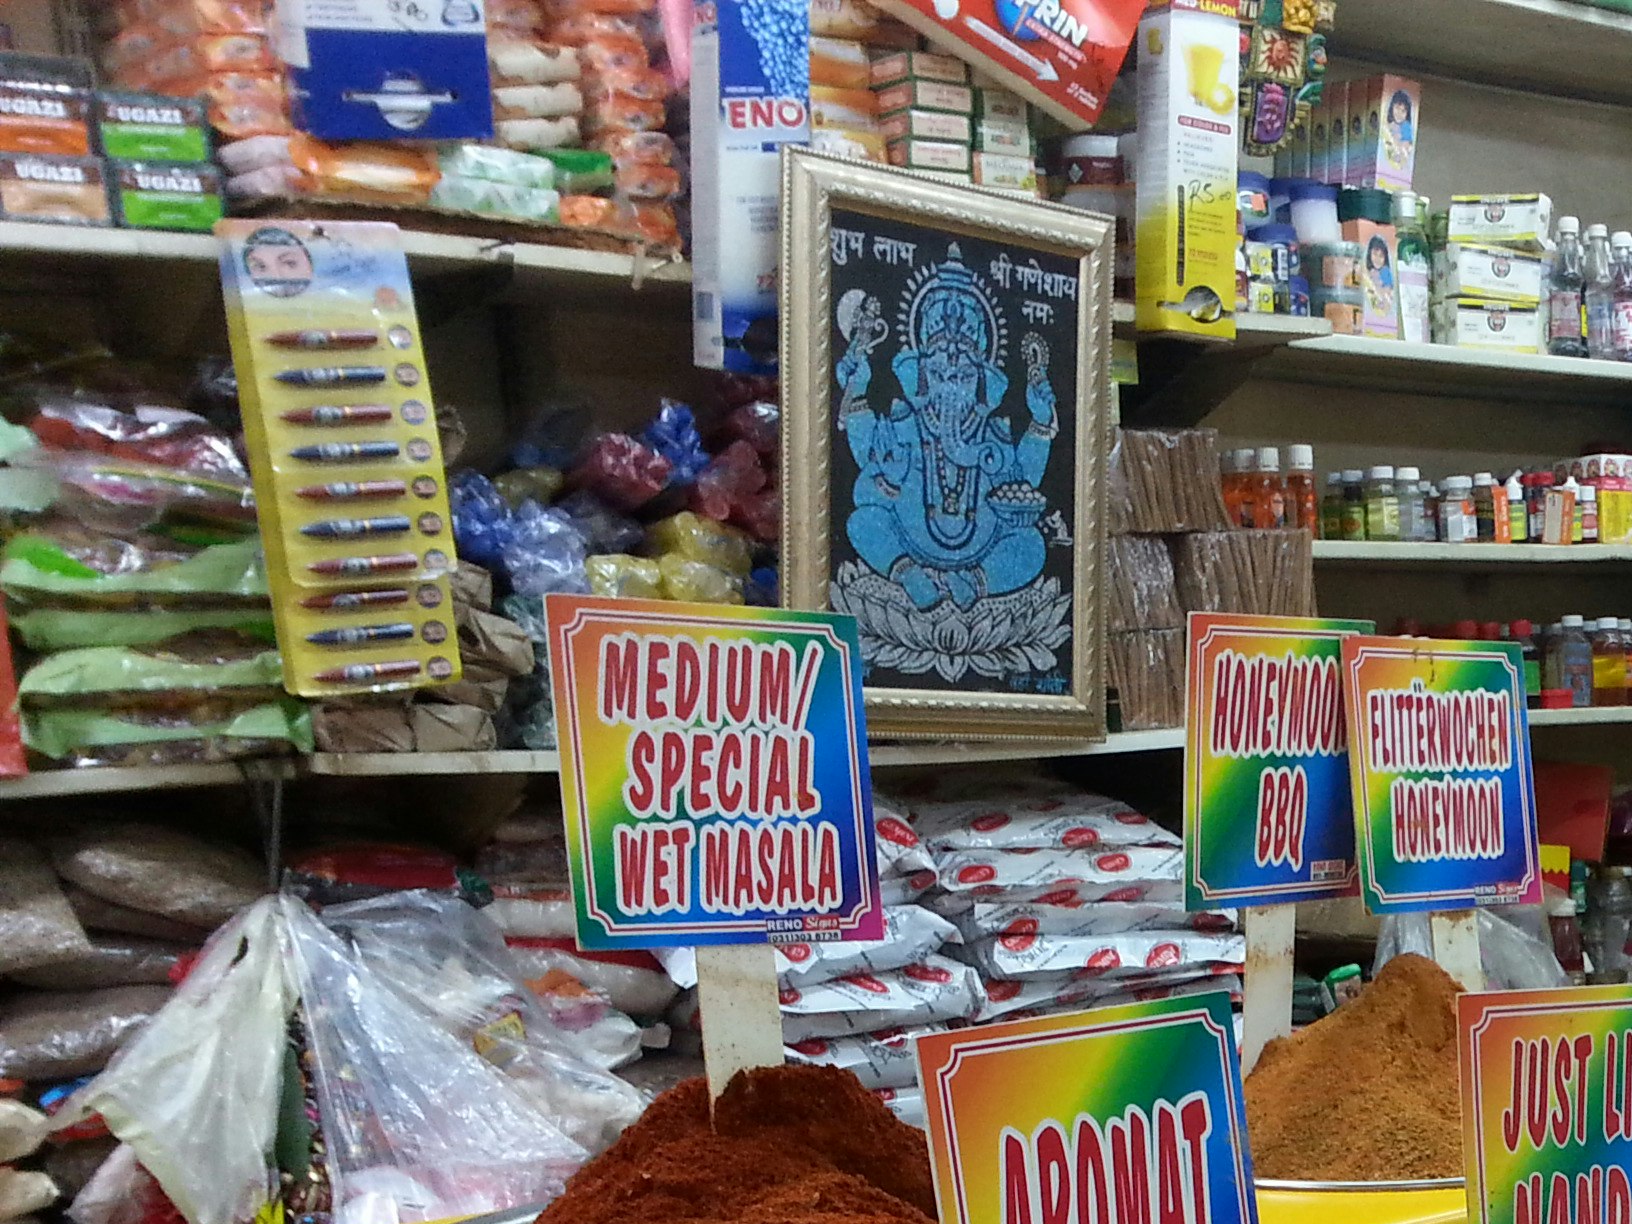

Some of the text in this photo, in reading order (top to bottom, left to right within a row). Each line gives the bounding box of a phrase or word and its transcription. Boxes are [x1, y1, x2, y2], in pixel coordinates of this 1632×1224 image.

[727, 98, 805, 129] ENO
[600, 632, 822, 731] MEDIUM/
[625, 729, 820, 819] SPECIAL
[1256, 765, 1307, 871] BBQ
[1391, 775, 1504, 862] HONEYMOON
[614, 821, 842, 914] WET MASALA
[766, 918, 803, 931] RENO
[1502, 1033, 1592, 1151] JUST
